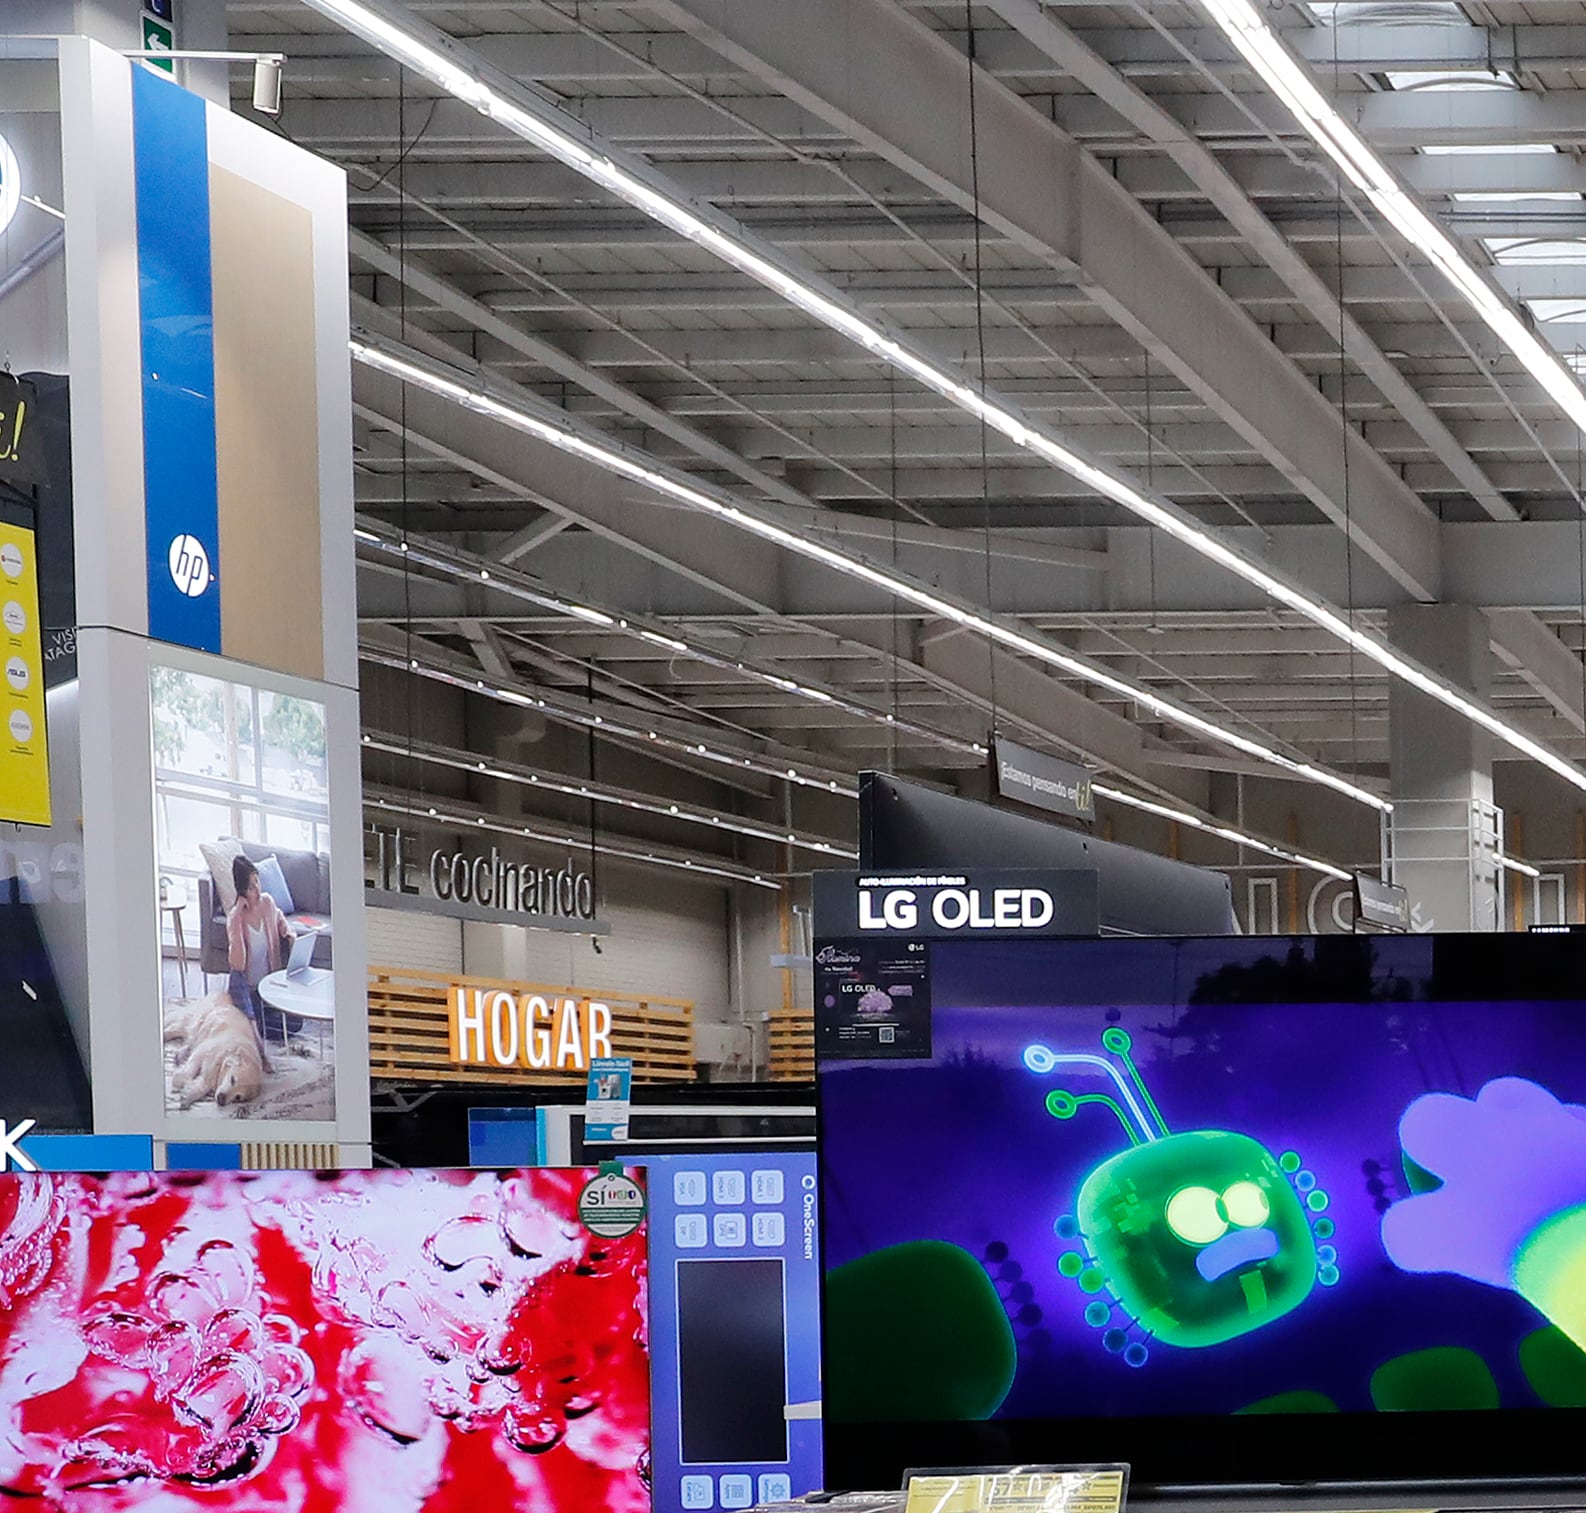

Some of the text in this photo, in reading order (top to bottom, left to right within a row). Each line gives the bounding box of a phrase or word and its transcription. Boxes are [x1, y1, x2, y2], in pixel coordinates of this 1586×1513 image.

[430, 846, 593, 920] cocinando
[858, 888, 1055, 929] LG OLED
[448, 985, 613, 1072] HOGAR
[803, 1193, 815, 1261] OneScreen
